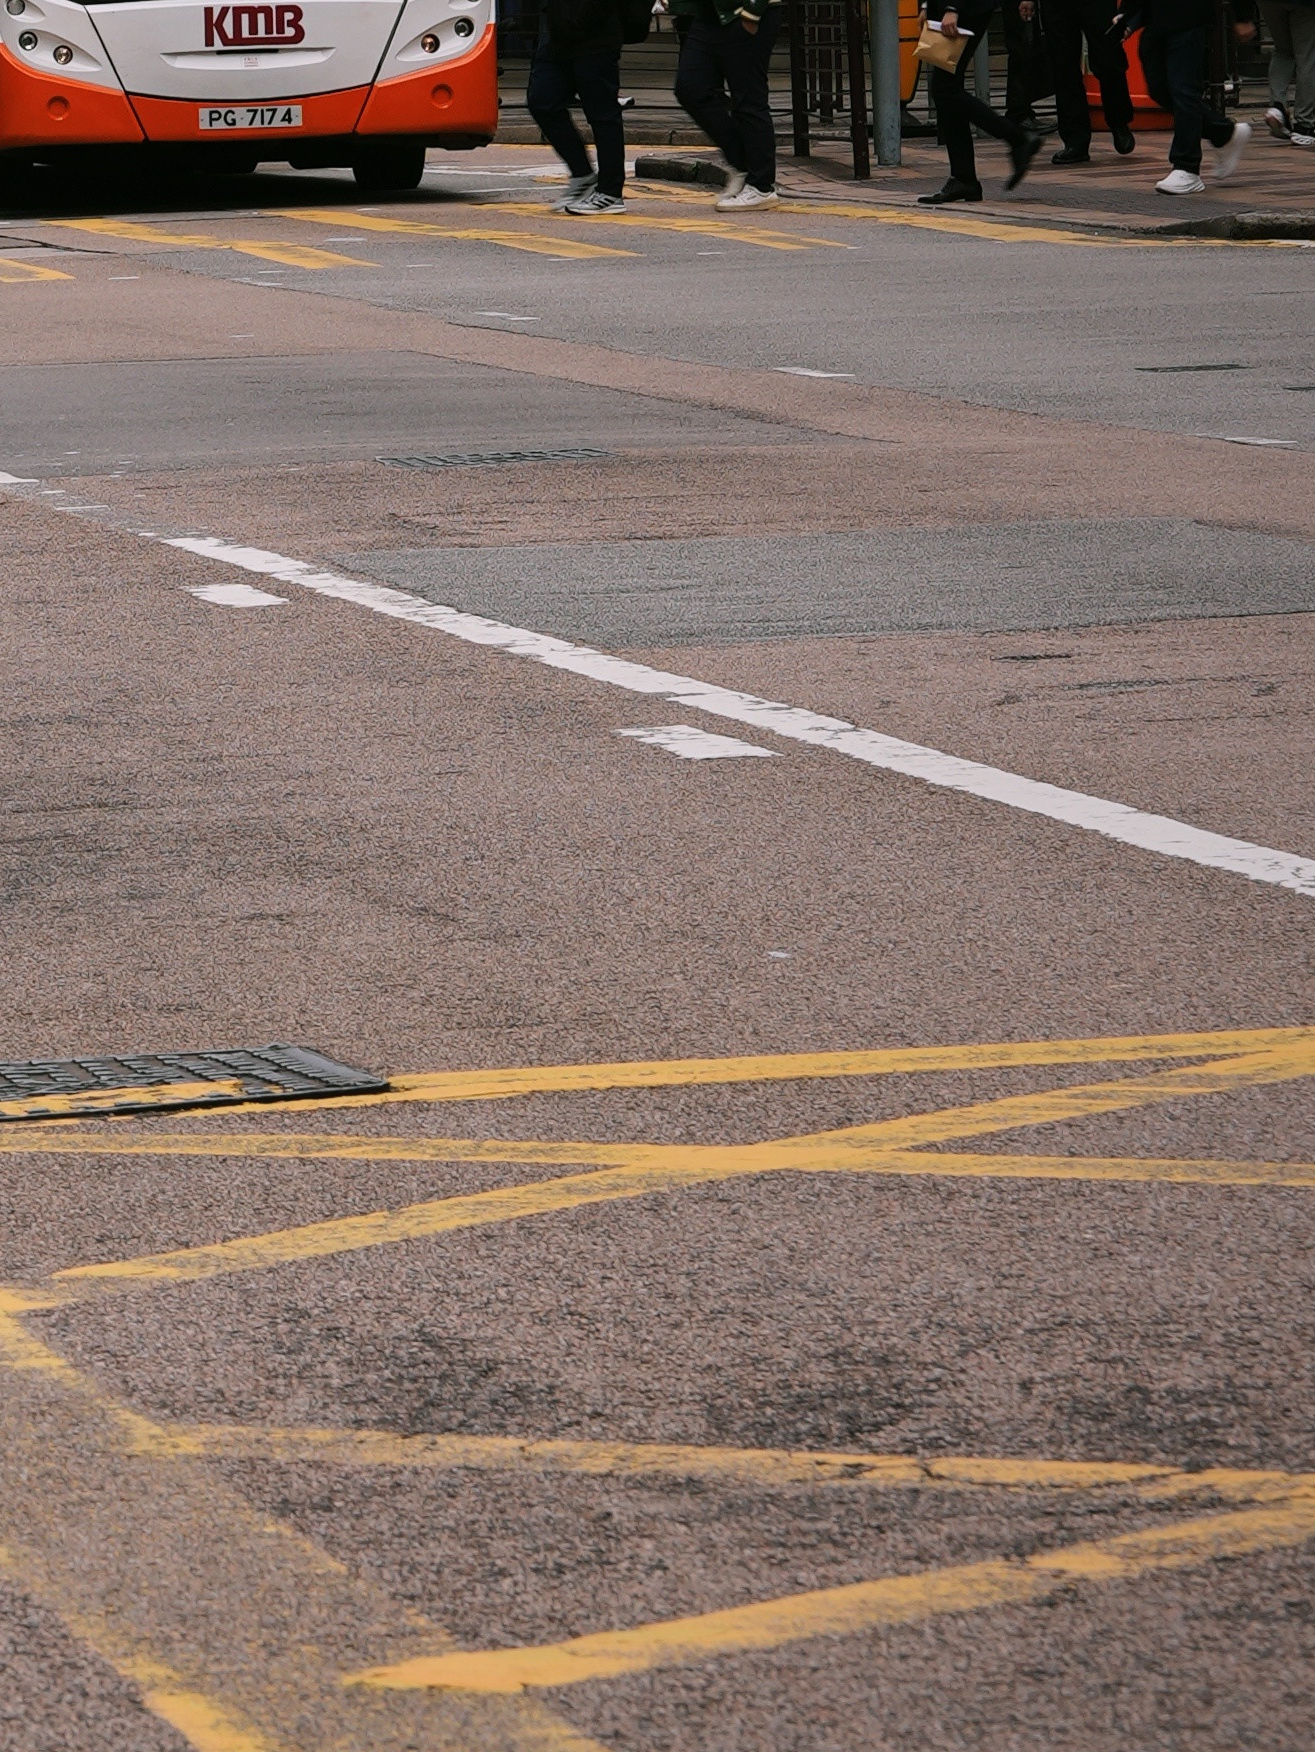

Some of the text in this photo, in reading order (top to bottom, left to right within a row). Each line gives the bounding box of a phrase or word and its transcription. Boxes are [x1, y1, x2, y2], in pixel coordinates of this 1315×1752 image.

[203, 4, 306, 47] KMB
[208, 107, 293, 127] PG 7174
